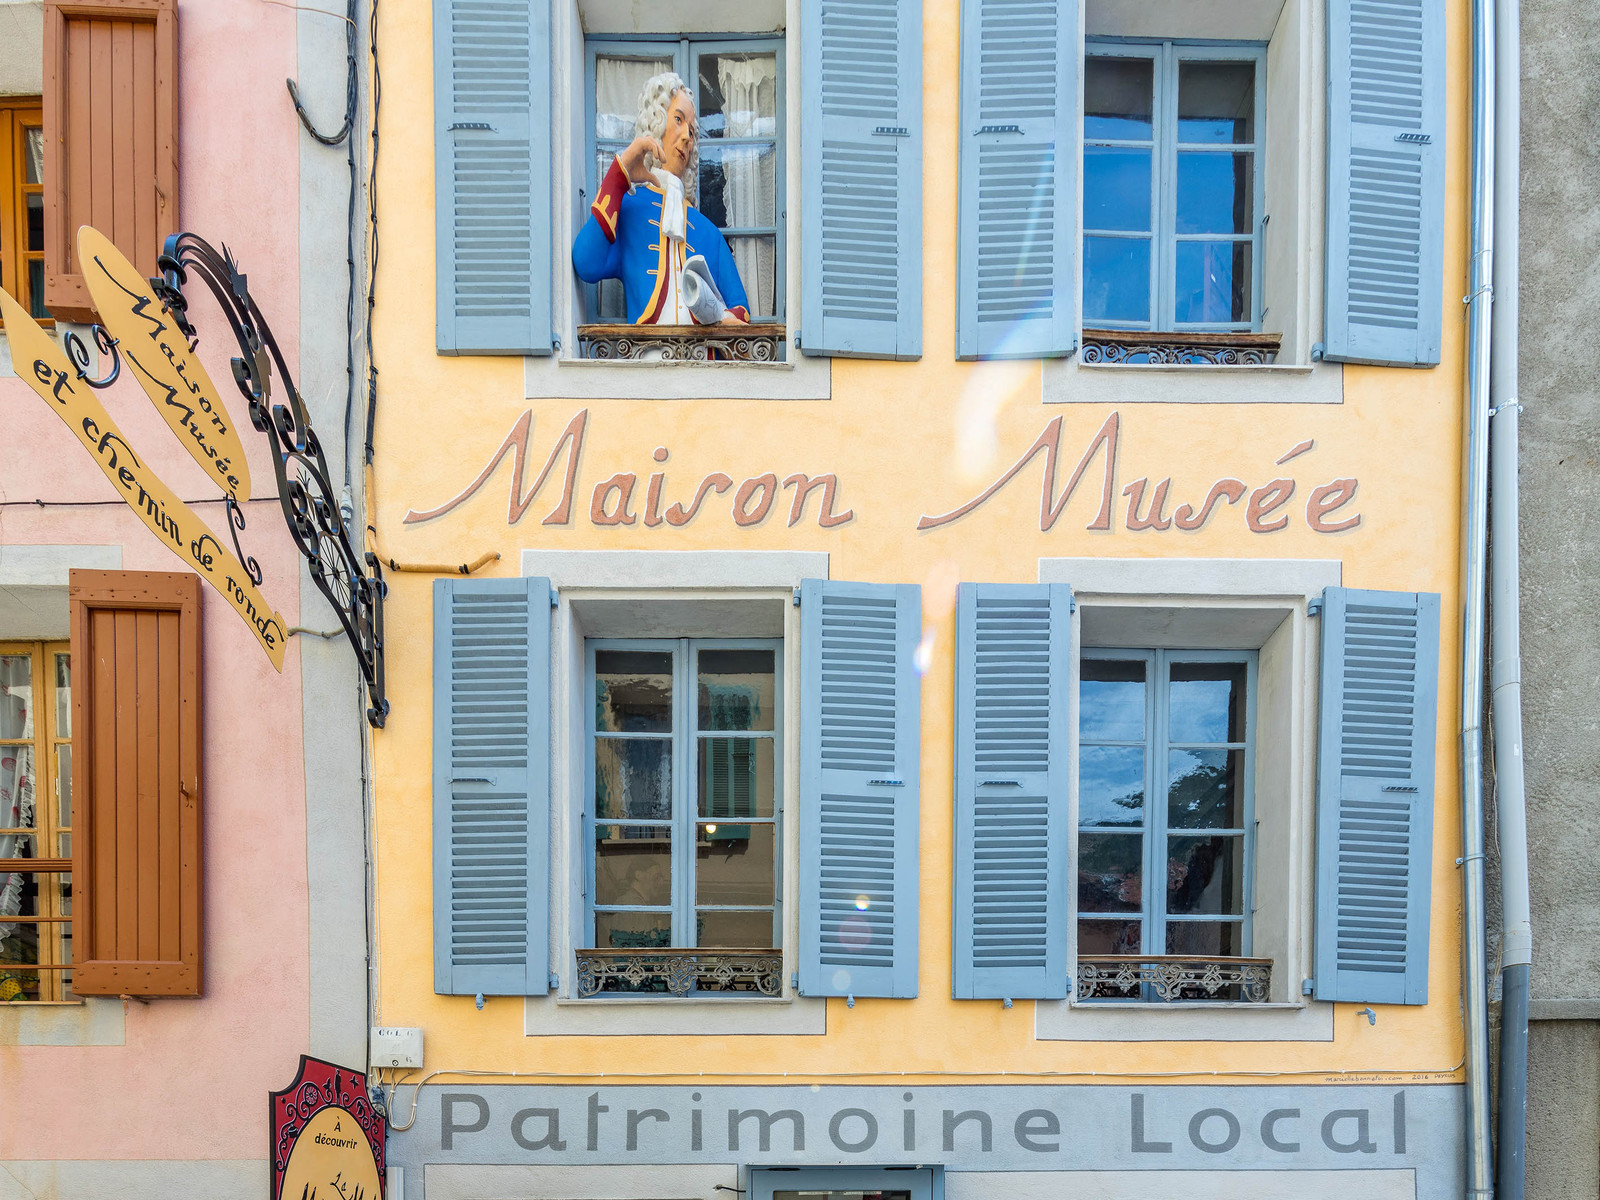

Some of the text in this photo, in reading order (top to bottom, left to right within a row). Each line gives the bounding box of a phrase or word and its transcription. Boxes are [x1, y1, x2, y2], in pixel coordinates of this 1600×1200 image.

[94, 255, 228, 436] Maison
[127, 350, 239, 490] Musée
[402, 408, 1362, 533] Maison Musée
[33, 359, 285, 650] et chemin de ronde
[314, 1133, 357, 1149] découvrir
[334, 1116, 341, 1132] À
[441, 1089, 1405, 1155] Patrimoine Local
